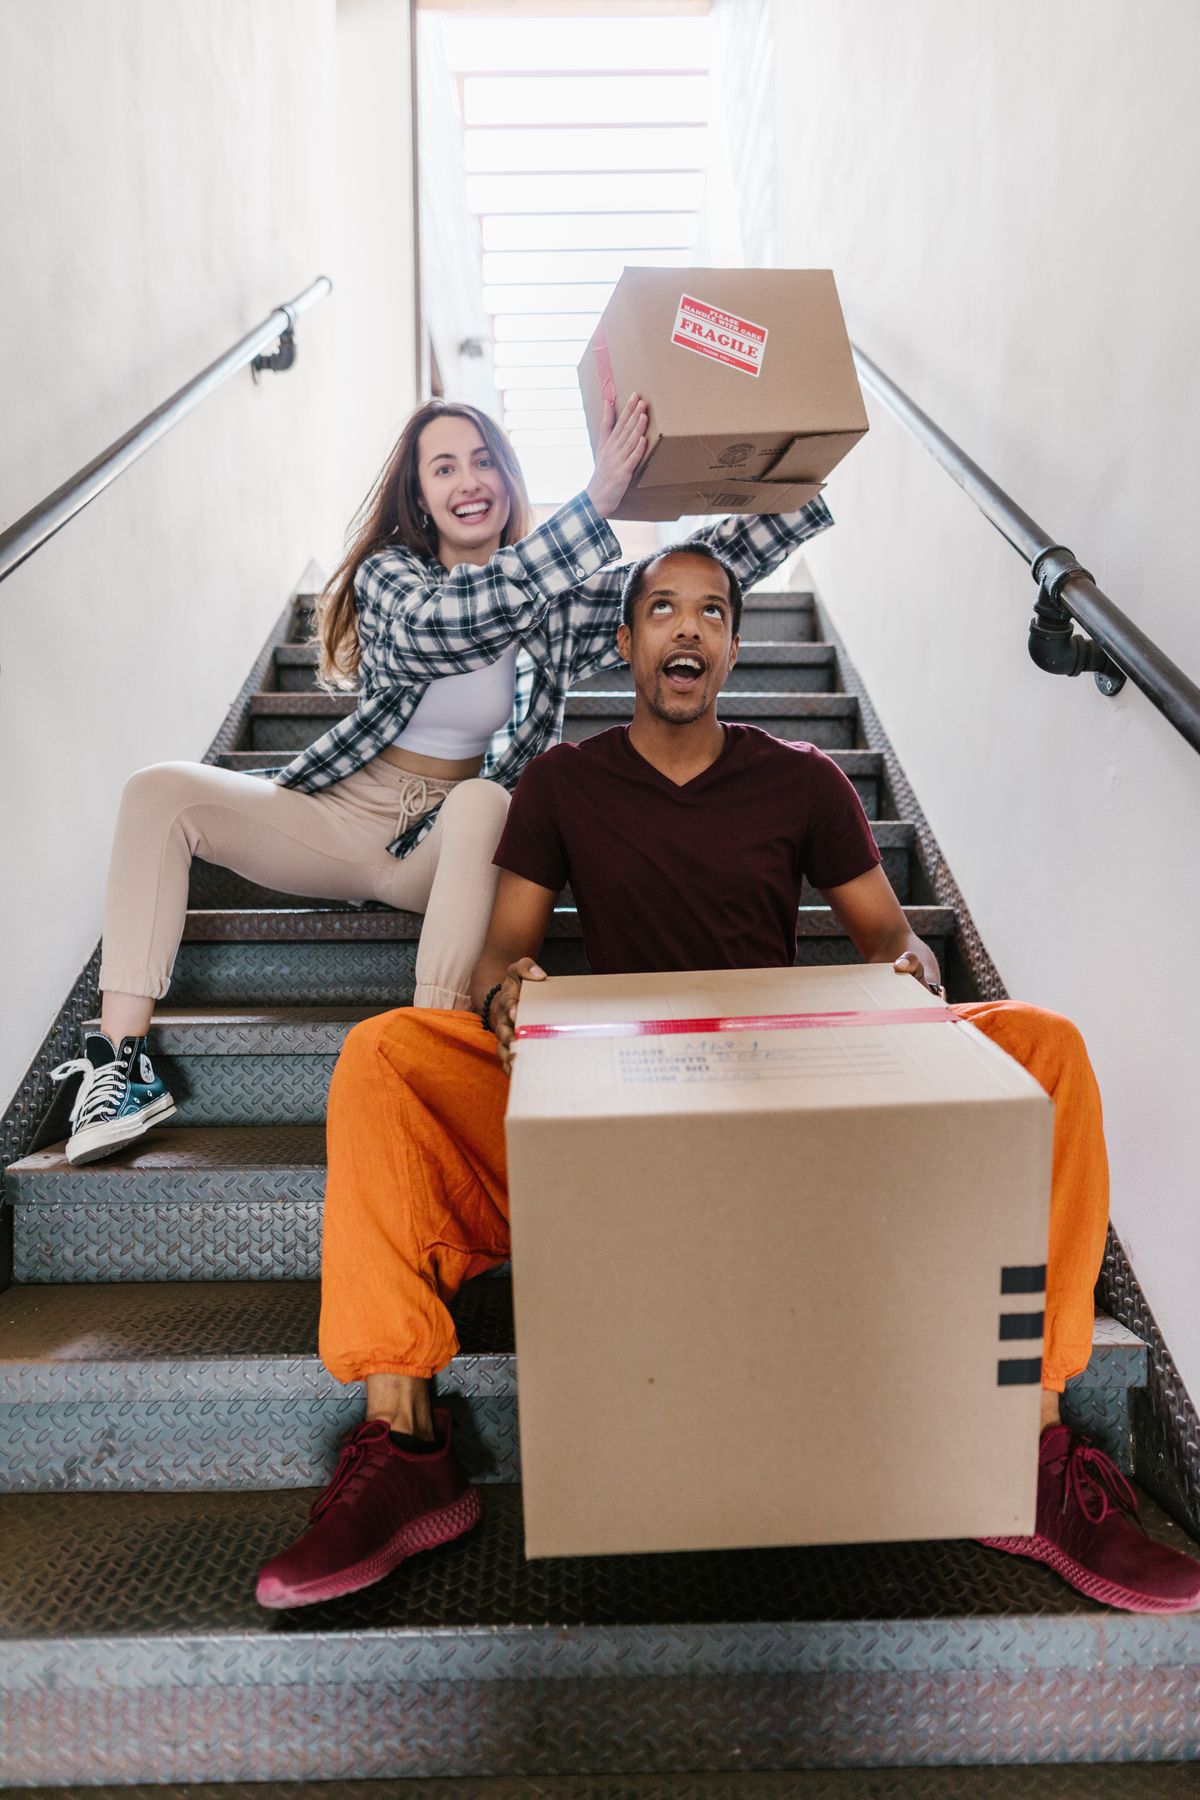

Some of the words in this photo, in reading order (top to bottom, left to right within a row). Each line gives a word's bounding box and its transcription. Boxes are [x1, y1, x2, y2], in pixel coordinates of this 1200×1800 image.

[684, 305, 717, 323] HANDLE
[717, 319, 740, 332] WITH
[741, 328, 763, 341] CARE
[709, 310, 740, 326] PLEASE
[680, 317, 759, 359] FRAGILE
[702, 347, 719, 358] THANK
[719, 354, 730, 362] YOU
[619, 1048, 664, 1057] NAME
[620, 1056, 708, 1064] CONTENTS
